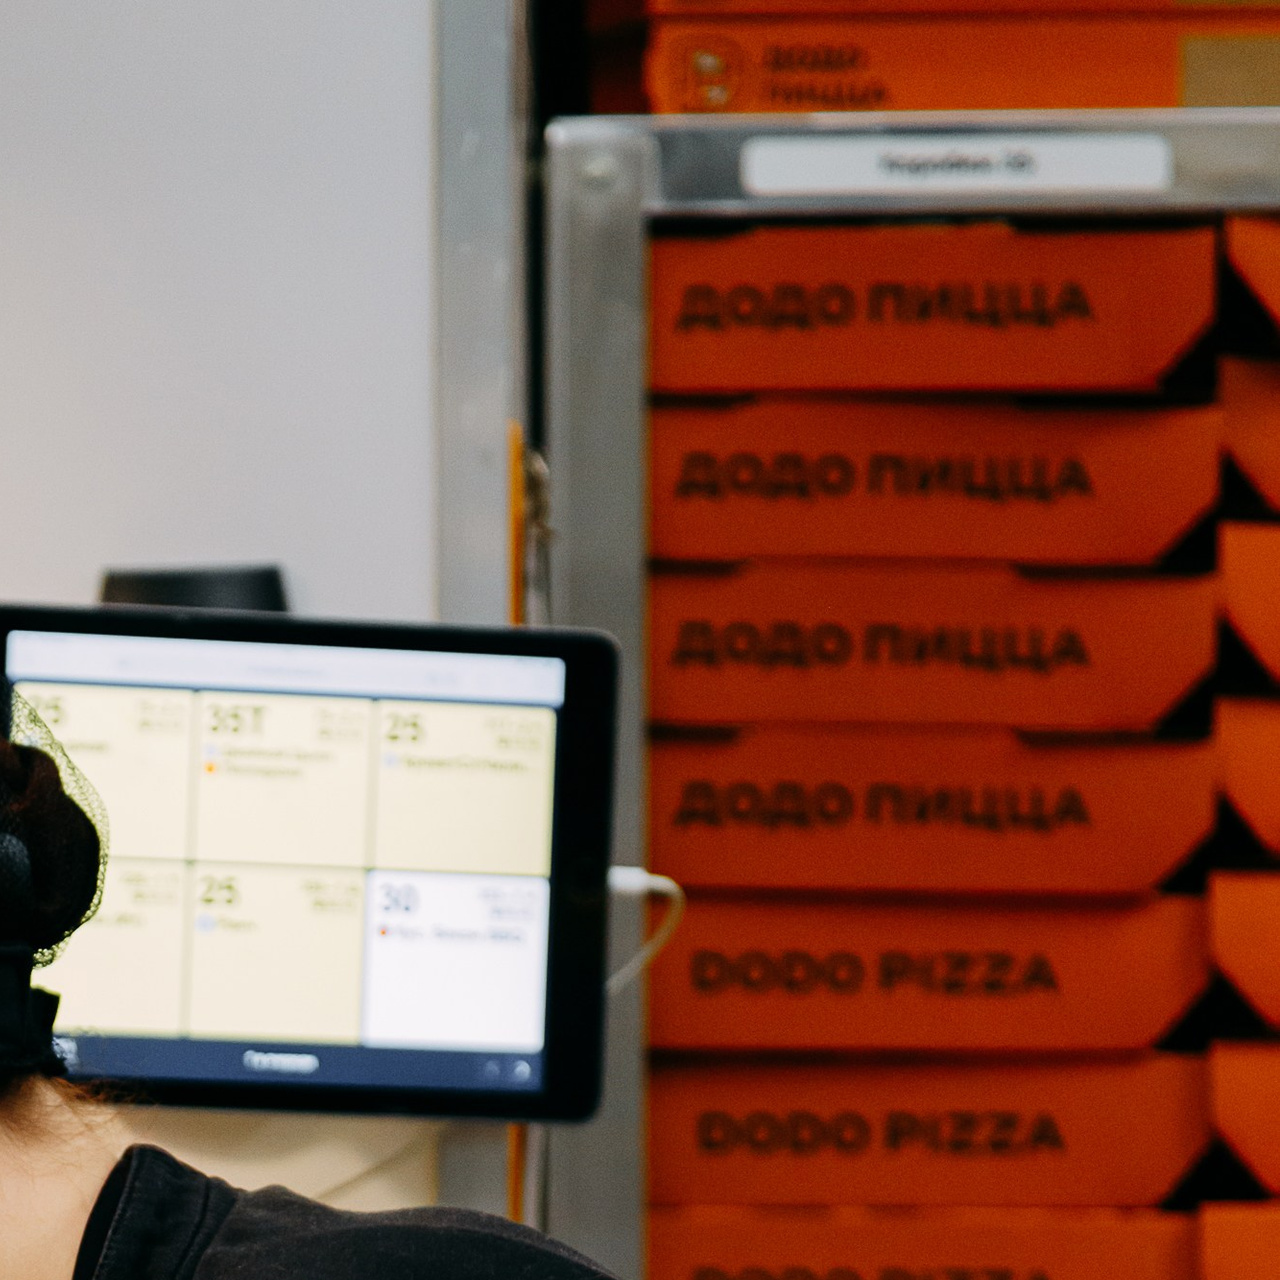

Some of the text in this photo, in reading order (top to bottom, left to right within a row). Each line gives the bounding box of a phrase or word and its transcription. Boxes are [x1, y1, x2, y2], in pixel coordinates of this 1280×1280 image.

[675, 282, 1095, 333] ДОДО ПИЦЦА
[674, 452, 1094, 504] ДОДО ПИЦЦА
[670, 620, 1091, 676] ДОДО ПИЦЦА
[671, 780, 1092, 836] ДОДО ПИЦЦА
[689, 949, 1060, 997] DODO PIZZA
[695, 1110, 1066, 1158] DODO PIZZA
